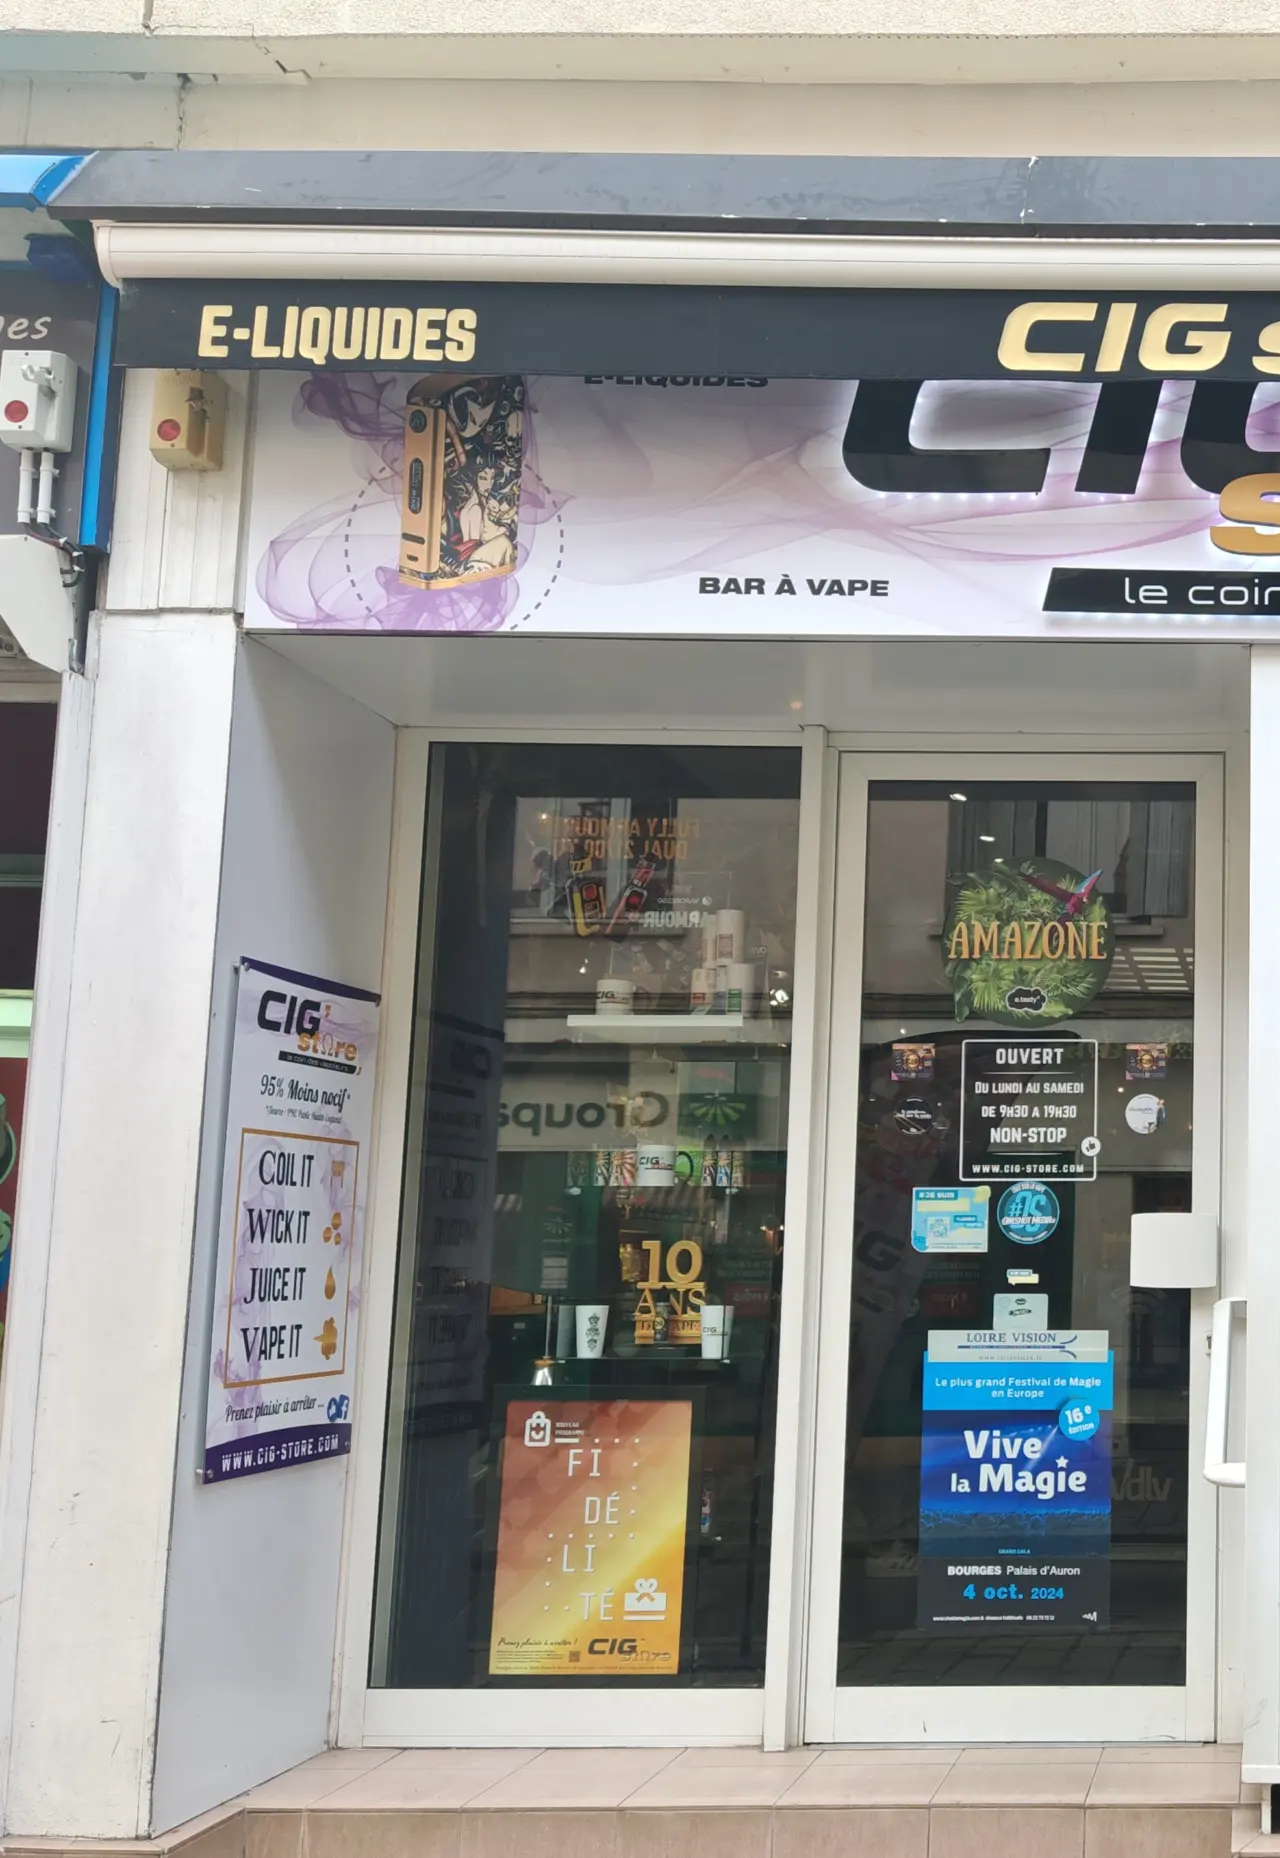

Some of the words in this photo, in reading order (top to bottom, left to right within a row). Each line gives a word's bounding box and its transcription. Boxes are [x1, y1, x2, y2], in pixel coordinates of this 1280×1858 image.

[198, 304, 477, 364] E-LIQUIDES
[997, 301, 1232, 373] CIG
[699, 576, 765, 596] BAR
[774, 573, 797, 596] À
[806, 578, 889, 598] VAPE
[1123, 576, 1168, 605] le
[948, 920, 1107, 960] AMAZONE
[995, 1047, 1064, 1065] OUVERT
[260, 1074, 284, 1098] 95%
[287, 1079, 319, 1103] Moins
[974, 1081, 990, 1094] DU
[992, 1081, 1022, 1094] LUNDI
[1025, 1082, 1041, 1094] AU
[1043, 1082, 1084, 1094] SAMEDI
[981, 1105, 996, 1118] DE
[999, 1105, 1029, 1118] 9H30
[1043, 1105, 1077, 1118] 19H30
[990, 1127, 1067, 1143] NON-STOP
[258, 1150, 297, 1187] COIL
[300, 1154, 314, 1188] IT
[972, 1163, 1084, 1173] WWW.CIG-STORE.COM
[247, 1208, 293, 1244] WICK
[296, 1211, 310, 1244] IT
[641, 1240, 703, 1284] 10
[243, 1267, 289, 1304] JUICE
[292, 1267, 307, 1301] IT
[240, 1325, 287, 1363] VAPE
[289, 1324, 303, 1358] IT
[966, 1332, 1007, 1343] LOIRE
[1012, 1332, 1057, 1343] VISION
[935, 1377, 947, 1387] Le
[950, 1377, 973, 1389] plus
[975, 1377, 1006, 1389] grand
[1008, 1377, 1050, 1387] Festival
[1053, 1377, 1067, 1387] de
[1069, 1377, 1101, 1389] Magie
[991, 1390, 1004, 1398] en
[1007, 1389, 1044, 1399] Europe
[225, 1406, 254, 1423] Prenez
[254, 1402, 281, 1422] plaisir
[290, 1395, 317, 1412] arrêter
[963, 1430, 1042, 1459] Vive
[567, 1449, 602, 1477] FI
[951, 1473, 971, 1493] la
[979, 1456, 1088, 1500] Magie
[583, 1491, 620, 1525] DÉ
[562, 1544, 596, 1573] LI
[947, 1565, 1002, 1576] BOURGES
[1006, 1565, 1038, 1576] Palais
[1039, 1565, 1081, 1576] d'Auron
[578, 1588, 615, 1621] TÉ
[962, 1584, 976, 1599] 4
[983, 1584, 1024, 1600] oct.
[1030, 1587, 1065, 1600] 2024
